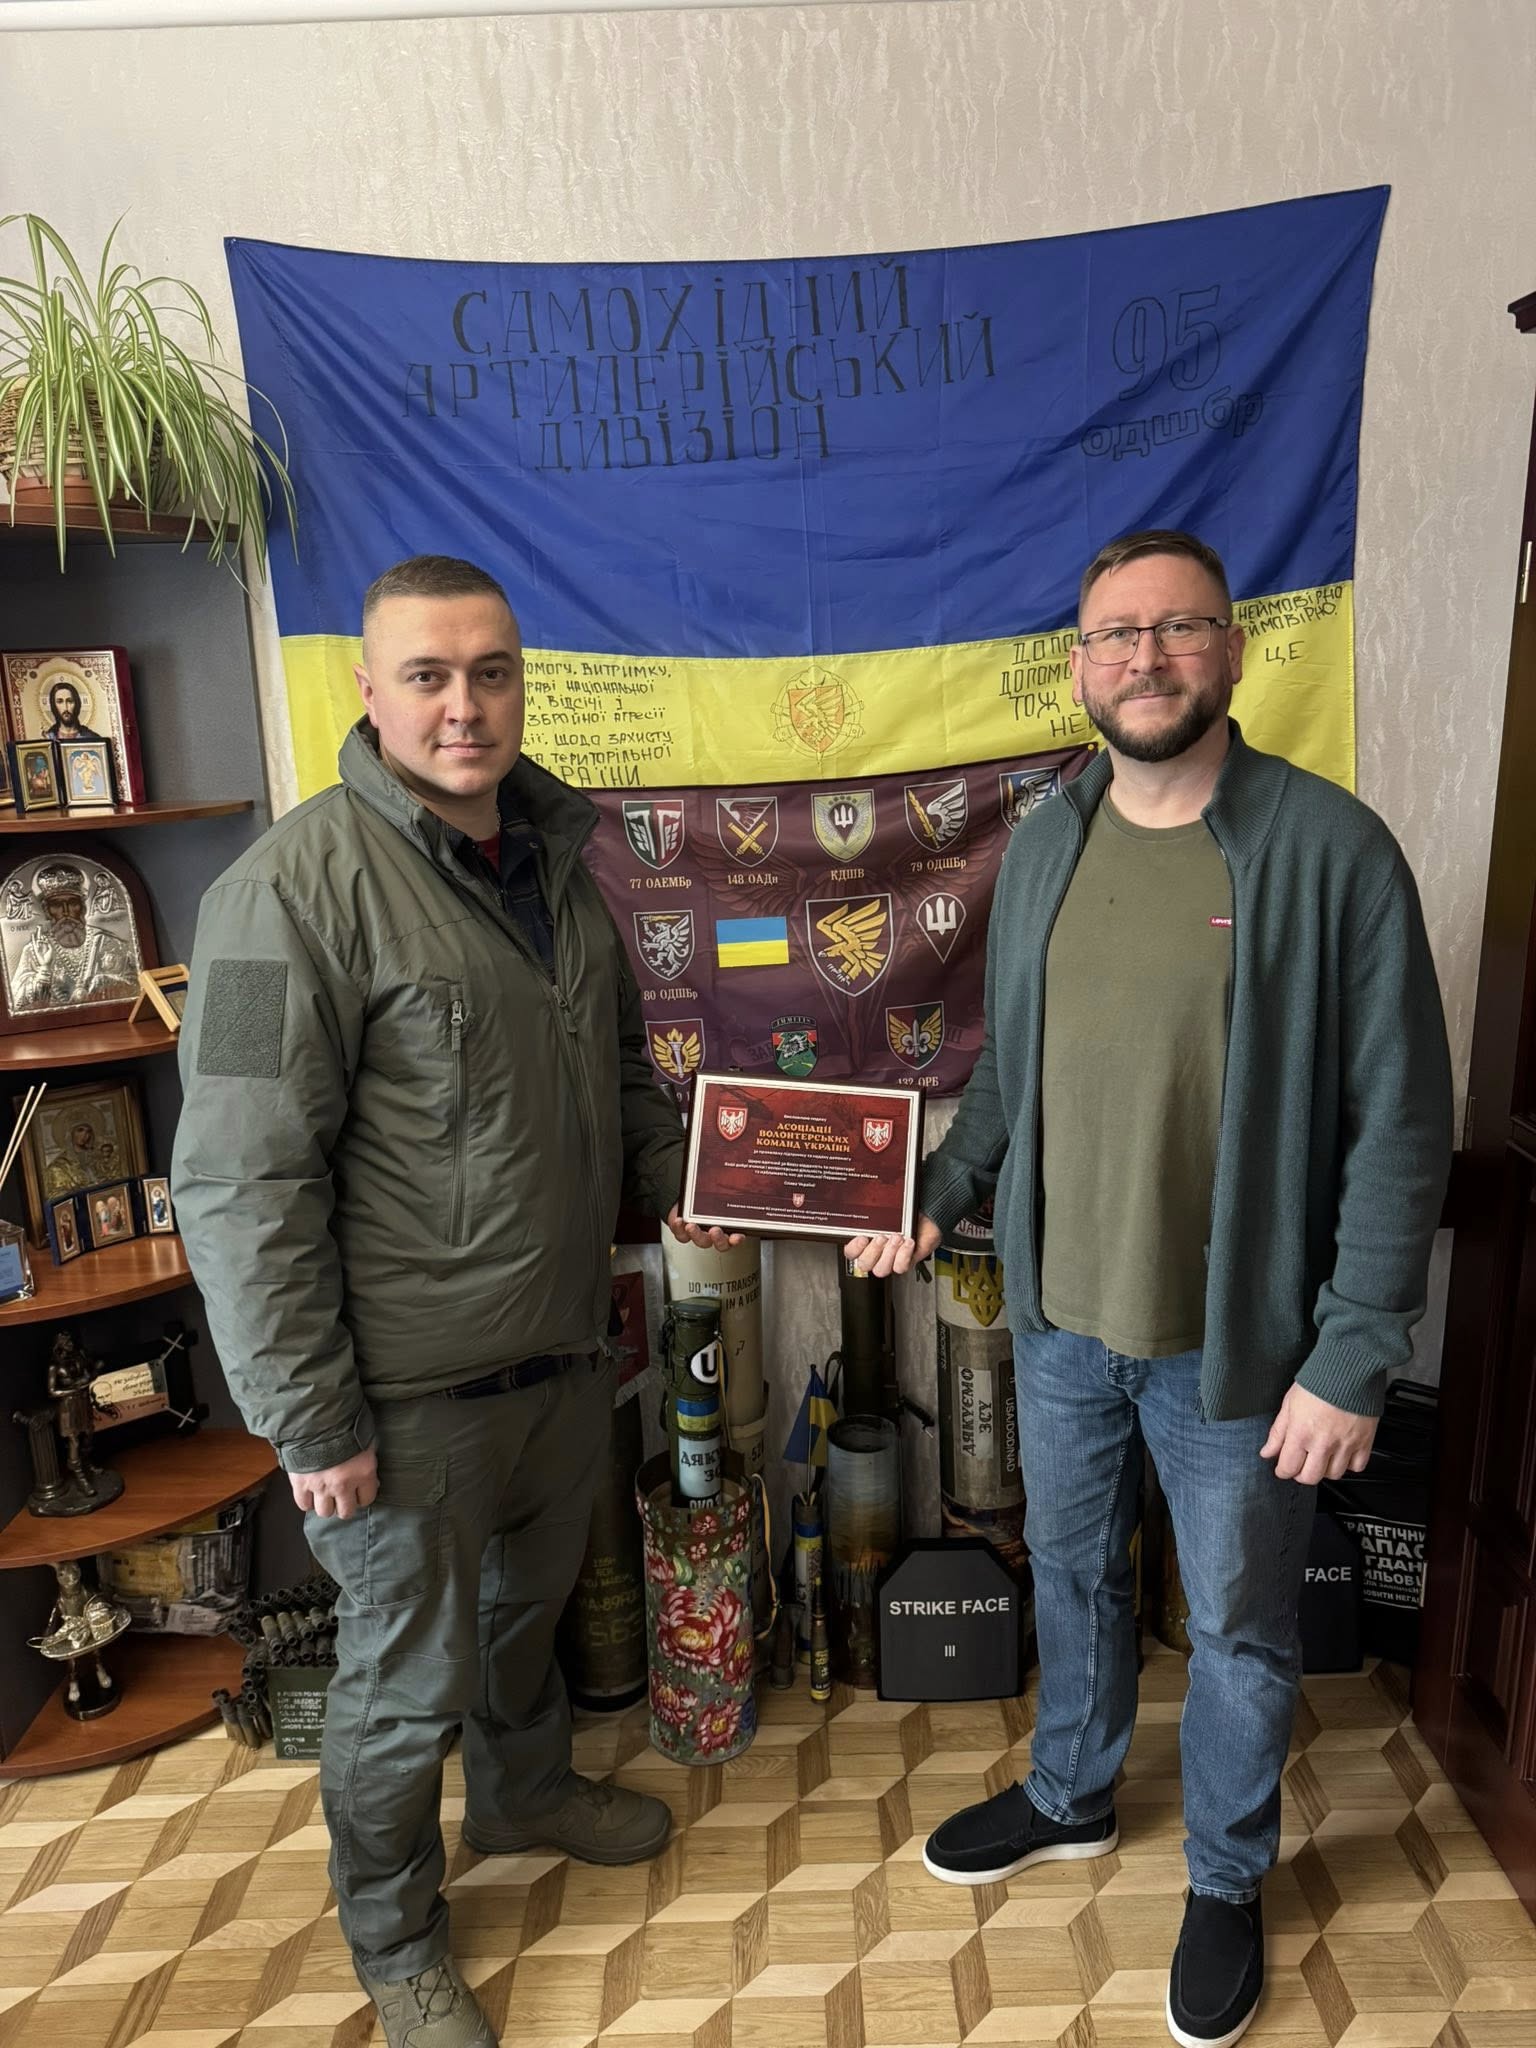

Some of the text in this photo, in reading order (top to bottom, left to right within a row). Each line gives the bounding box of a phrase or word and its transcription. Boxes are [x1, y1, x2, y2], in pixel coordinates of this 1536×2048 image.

[1112, 285, 1222, 400] 95
[1244, 602, 1338, 638] ЙМОВІРНО.
[1012, 634, 1074, 665] ДОПО
[1265, 641, 1305, 667] ЦЕ
[999, 660, 1072, 696] ДОПОМО
[526, 680, 556, 694] РАВІ
[1008, 690, 1061, 720] ТОЖ
[830, 868, 865, 881] КДШВ
[910, 862, 923, 873] 79
[629, 878, 642, 889] 77
[727, 874, 745, 885] 148
[643, 989, 656, 1001] 80
[756, 1138, 801, 1150] КОМАНД
[688, 1282, 701, 1294] DO
[726, 1298, 736, 1310] IN
[978, 1400, 993, 1434] ЗСУ
[1361, 1536, 1425, 1560] АПАС
[1304, 1566, 1352, 1583] FACE
[889, 1597, 1010, 1615] STRIKE FACE
[944, 1645, 956, 1657] III
